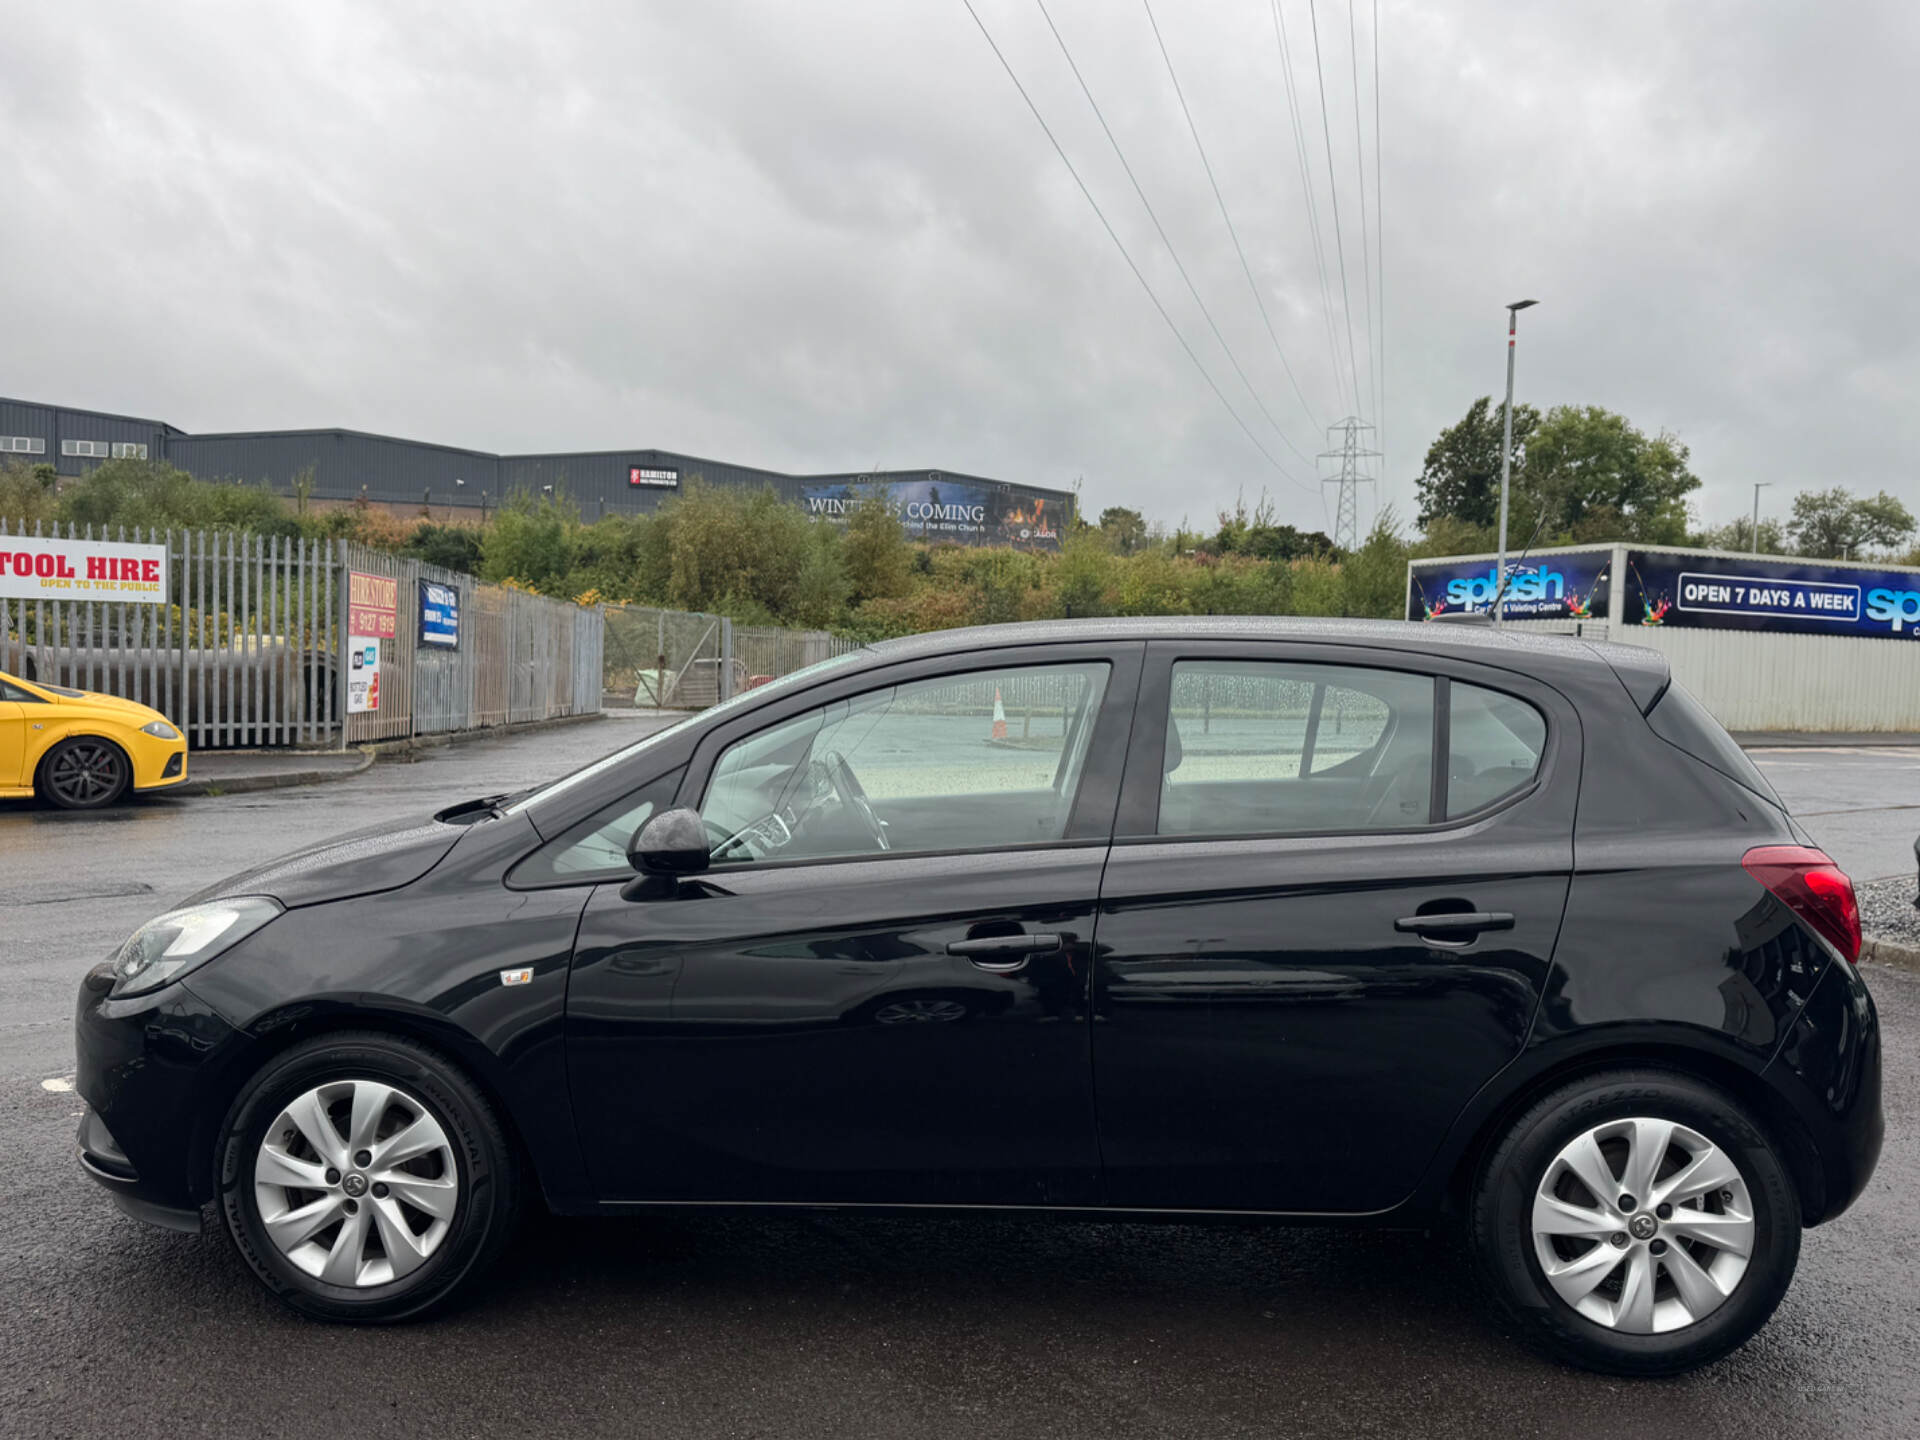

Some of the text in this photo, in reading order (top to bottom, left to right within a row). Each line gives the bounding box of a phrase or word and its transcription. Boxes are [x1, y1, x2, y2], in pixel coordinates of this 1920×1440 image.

[640, 470, 677, 480] HAMILTON
[907, 502, 985, 522] COMING
[926, 521, 938, 530] the
[87, 556, 160, 582] HIRE
[40, 579, 160, 592] OPEN TO THE PUBLIC
[1447, 564, 1564, 612] splash
[1685, 584, 1854, 611] OPEN 7 DAYS A WEEK
